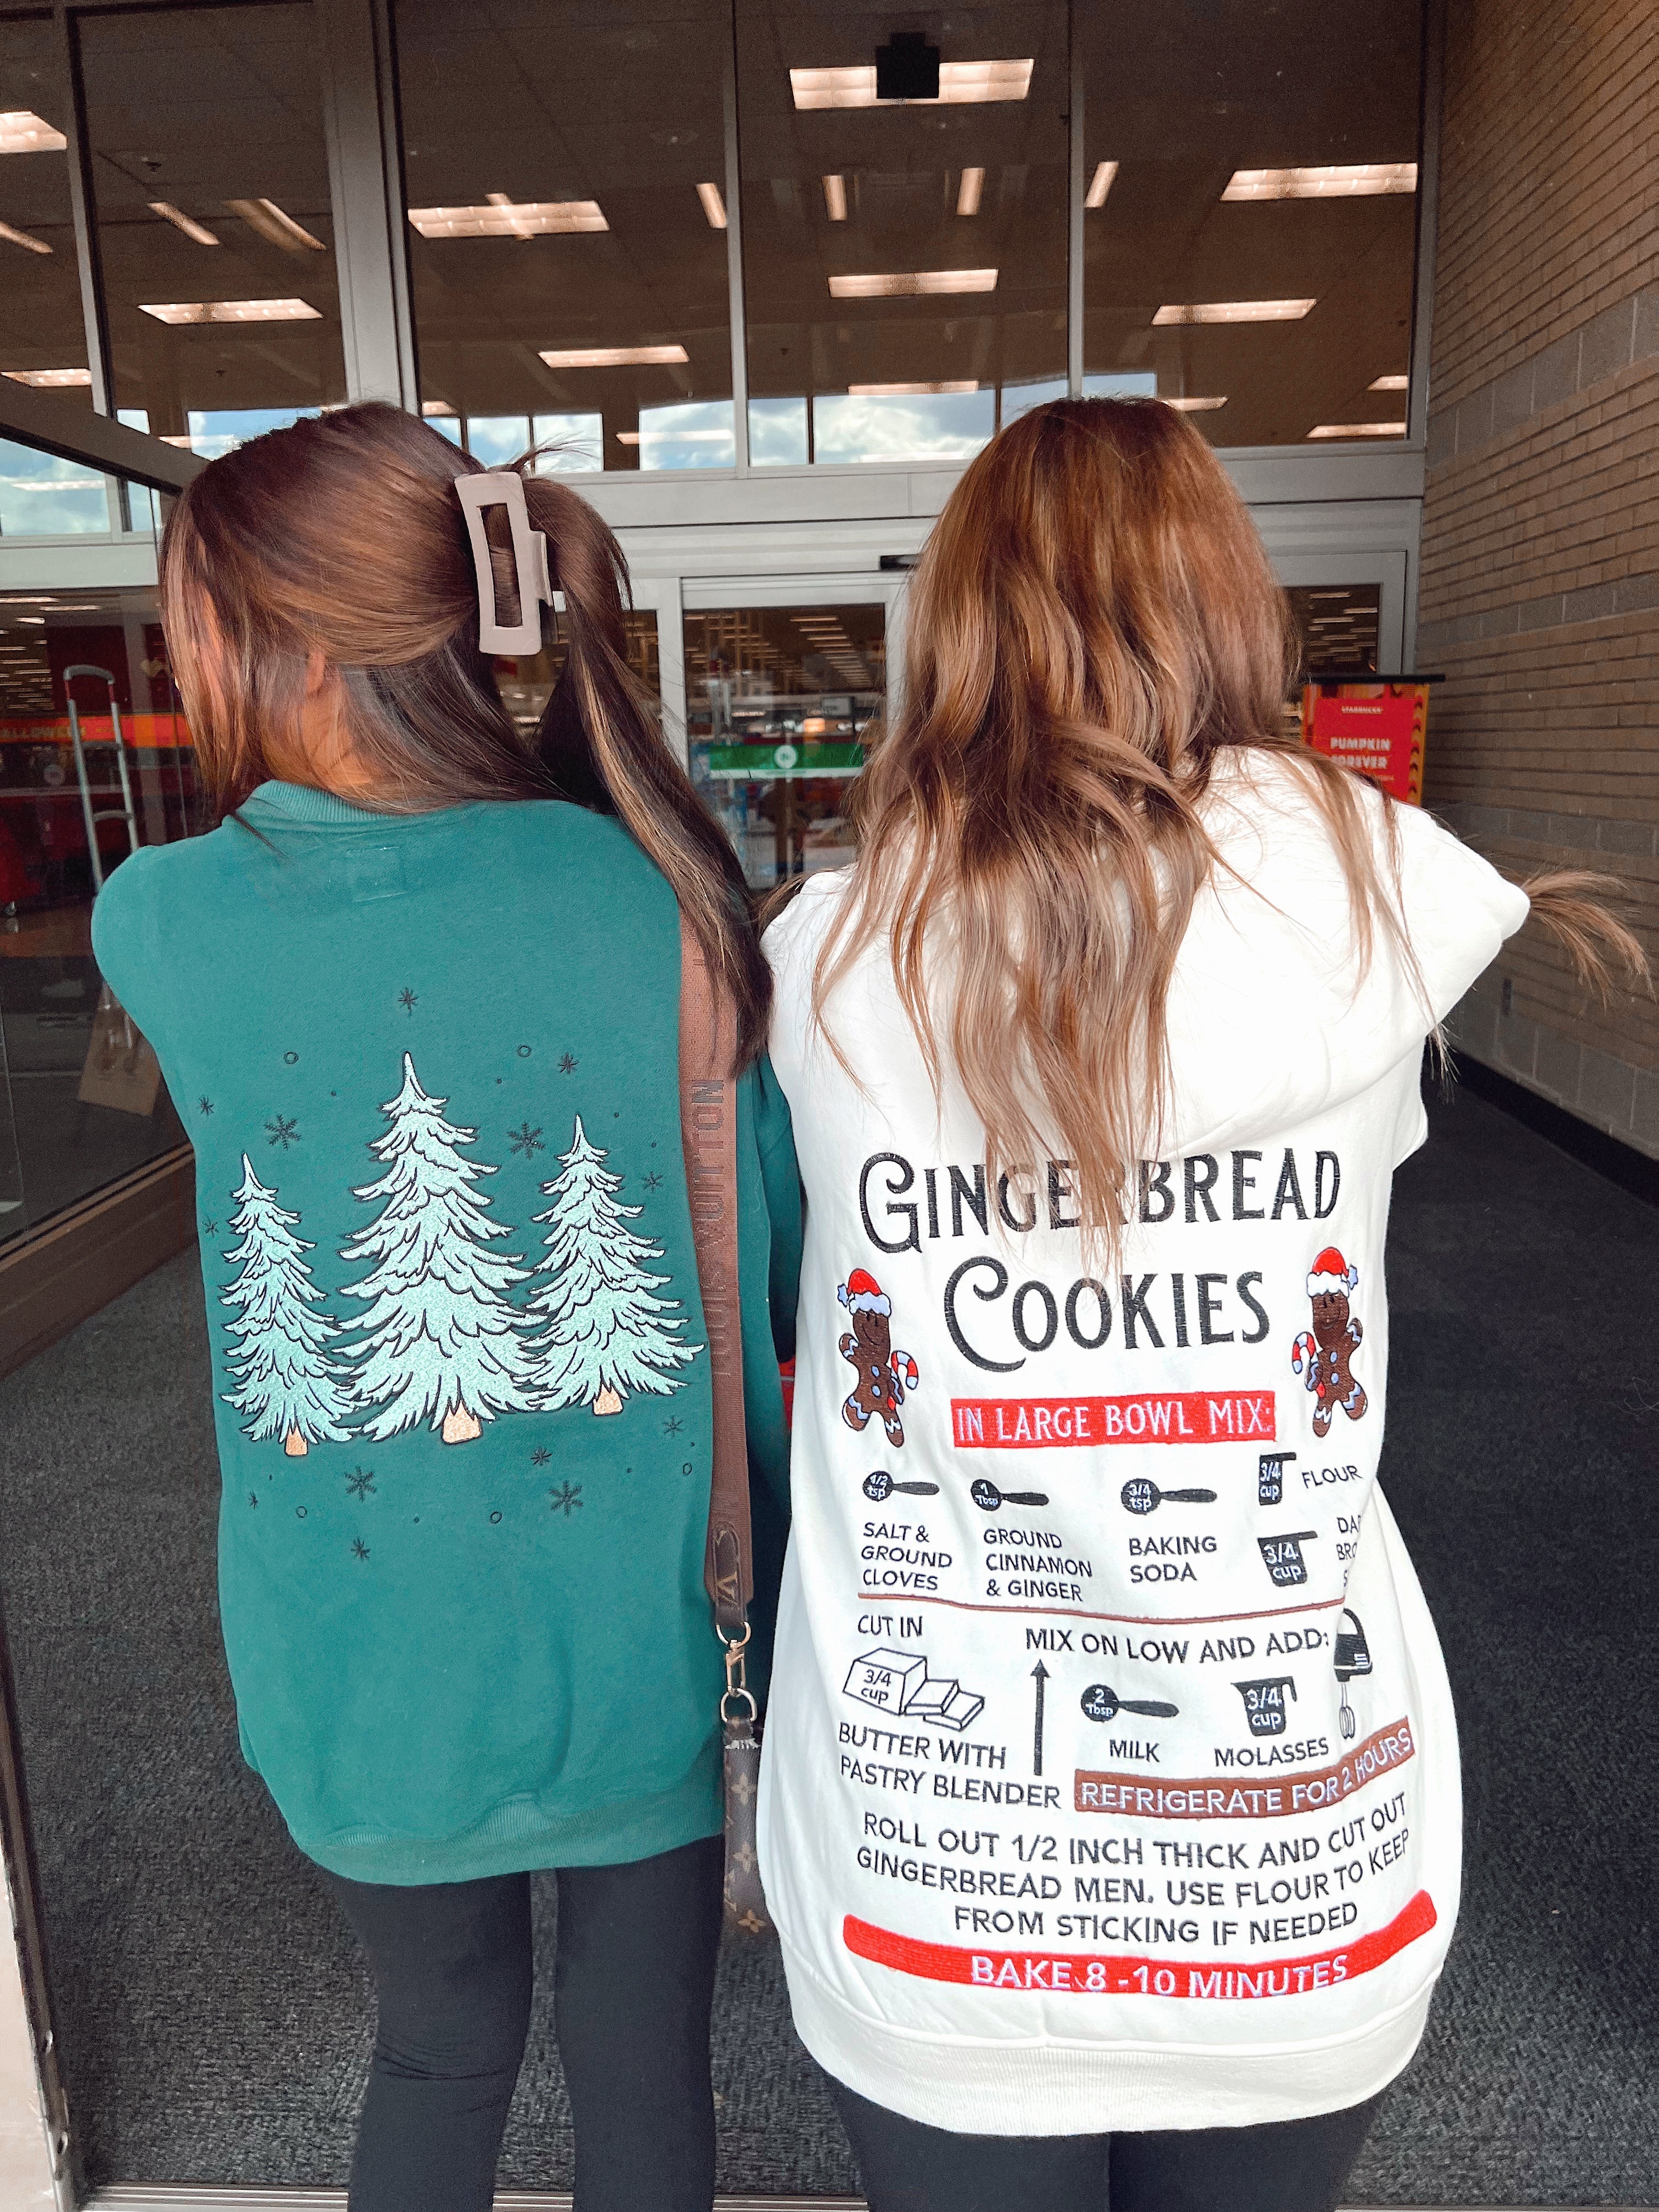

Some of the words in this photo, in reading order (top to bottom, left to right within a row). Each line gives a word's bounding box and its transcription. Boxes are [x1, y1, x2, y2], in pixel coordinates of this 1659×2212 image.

[1330, 737, 1391, 751] PUMPKIN
[860, 1148, 1340, 1253] GINGEBREAD
[945, 1256, 1269, 1372] COOKIES
[957, 1408, 984, 1440] IN
[997, 1405, 1091, 1440] LARGE
[1105, 1401, 1193, 1436] BOWL
[870, 1475, 888, 1485] 1/2
[1261, 1462, 1281, 1481] 3/4
[1302, 1465, 1362, 1488] FLOUR
[867, 1485, 885, 1498] tsp
[980, 1483, 989, 1495] 1
[1128, 1485, 1151, 1497] 3/4
[1260, 1485, 1279, 1500] cup
[1130, 1497, 1152, 1510] tsp
[864, 1522, 911, 1541] SALT
[916, 1525, 929, 1543] &
[984, 1528, 1062, 1548] GROUND
[861, 1545, 952, 1567] GROUND
[1129, 1536, 1217, 1556] BAKING
[1264, 1543, 1299, 1563] 3/4
[986, 1554, 1092, 1577] CINNAMON
[1131, 1562, 1198, 1583] SODA
[1273, 1565, 1302, 1581] cup
[863, 1569, 938, 1590] CLOVES
[987, 1578, 1001, 1596] &
[1008, 1579, 1083, 1602] GINGER
[858, 1615, 893, 1638] CUT
[900, 1616, 923, 1638] IN
[1026, 1628, 1074, 1651] MIX
[1082, 1633, 1118, 1656] ON
[1127, 1637, 1188, 1664] LOW
[1200, 1637, 1255, 1663] AND
[863, 1669, 891, 1687] 3/4
[861, 1688, 889, 1704] cup
[1096, 1688, 1105, 1703] 2
[1246, 1686, 1281, 1710] 3/4
[1086, 1702, 1113, 1717] Tbsp
[1251, 1712, 1281, 1730] cup
[839, 1722, 930, 1759] BUTTER
[938, 1737, 1007, 1770] WITH
[1110, 1739, 1160, 1762] MILK
[1215, 1737, 1329, 1767] MOLASSES
[840, 1754, 927, 1794] PASTRY
[934, 1774, 1061, 1809] BLENDER
[1081, 1781, 1282, 1814] REFRIGERATE
[1292, 1776, 1339, 1810] FOR
[1342, 1767, 1352, 1792] 2
[1355, 1728, 1412, 1782] HOURS
[865, 1812, 927, 1848] ROLL
[938, 1829, 999, 1857] OUT
[1012, 1834, 1058, 1861] 1/2
[1070, 1837, 1143, 1865] INCH
[1153, 1841, 1250, 1870] THICK
[1258, 1837, 1319, 1869] AND
[1328, 1817, 1365, 1853] CUT
[1371, 1791, 1406, 1832] OUT
[857, 1846, 1062, 1899] GINGERBREAD
[1075, 1876, 1153, 1904] MEN.
[1167, 1880, 1224, 1905] USE
[1235, 1872, 1330, 1908] FLOUR
[1333, 1860, 1363, 1892] TO
[1369, 1827, 1409, 1875] KEEP
[955, 1905, 1044, 1935] FROM
[1057, 1914, 1199, 1943] STICKING
[1213, 1920, 1238, 1945] IF
[1250, 1901, 1358, 1945] NEEDED
[971, 1955, 1073, 1990] BAKE
[1086, 1962, 1107, 1992] 8
[1188, 1954, 1348, 1999] MINUTES
